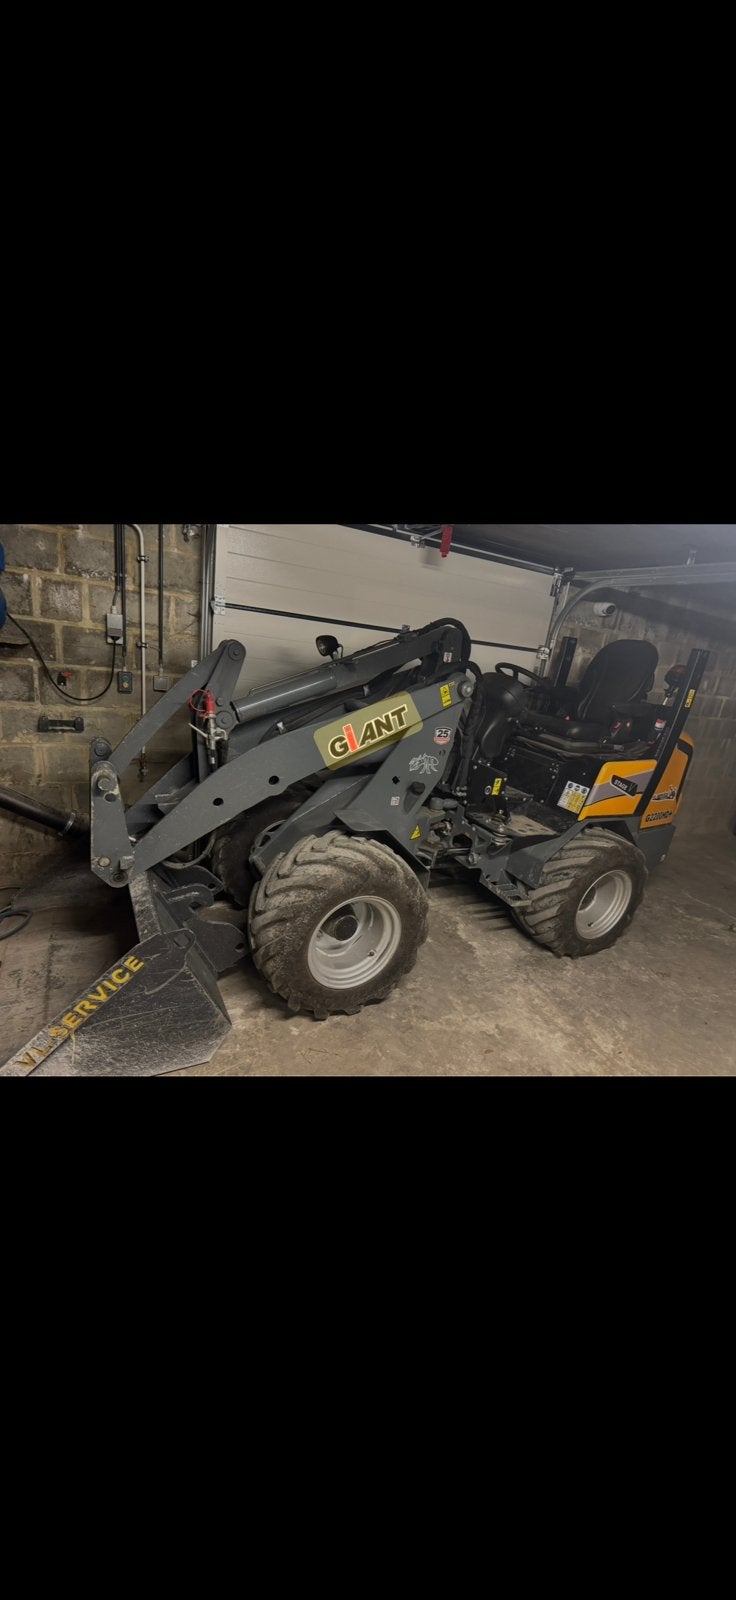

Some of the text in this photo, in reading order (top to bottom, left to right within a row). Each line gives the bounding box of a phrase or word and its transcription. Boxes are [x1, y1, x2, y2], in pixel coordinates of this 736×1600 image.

[328, 703, 408, 759] GIANT
[436, 729, 450, 738] 25
[613, 779, 629, 791] STAGE
[48, 955, 145, 1038] SERVICE
